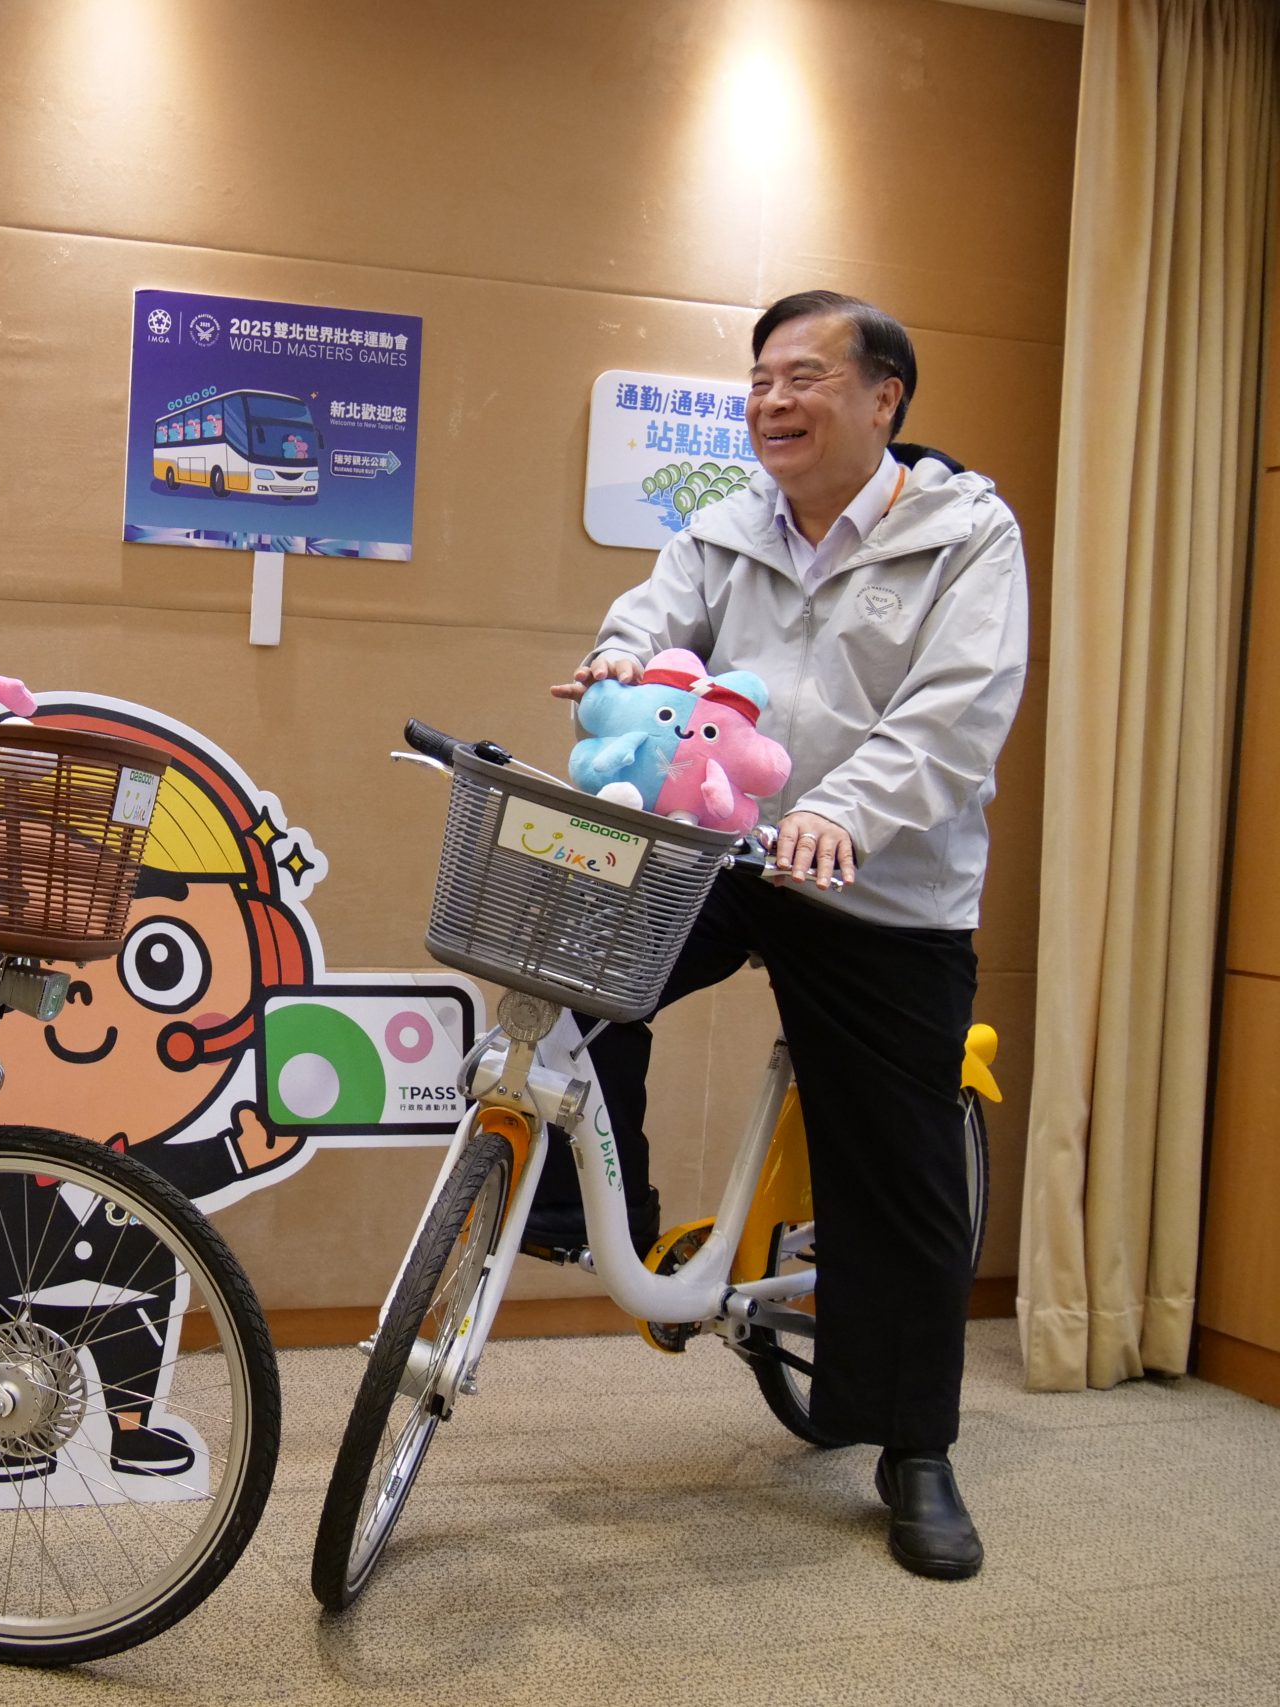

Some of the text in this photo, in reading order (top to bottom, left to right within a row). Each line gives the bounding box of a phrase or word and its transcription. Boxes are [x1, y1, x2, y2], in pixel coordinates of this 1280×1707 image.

[147, 335, 171, 344] IMGA
[229, 336, 282, 355] WORLD
[287, 343, 353, 362] MASTERS
[358, 349, 408, 367] GAMES
[167, 385, 217, 411] GO GO GO
[330, 400, 407, 424] 新北歡迎您
[330, 418, 356, 427] Welcome
[377, 423, 394, 431] Taipei
[394, 424, 406, 432] City
[570, 817, 640, 846] 0200001
[398, 1086, 457, 1100] TPASS
